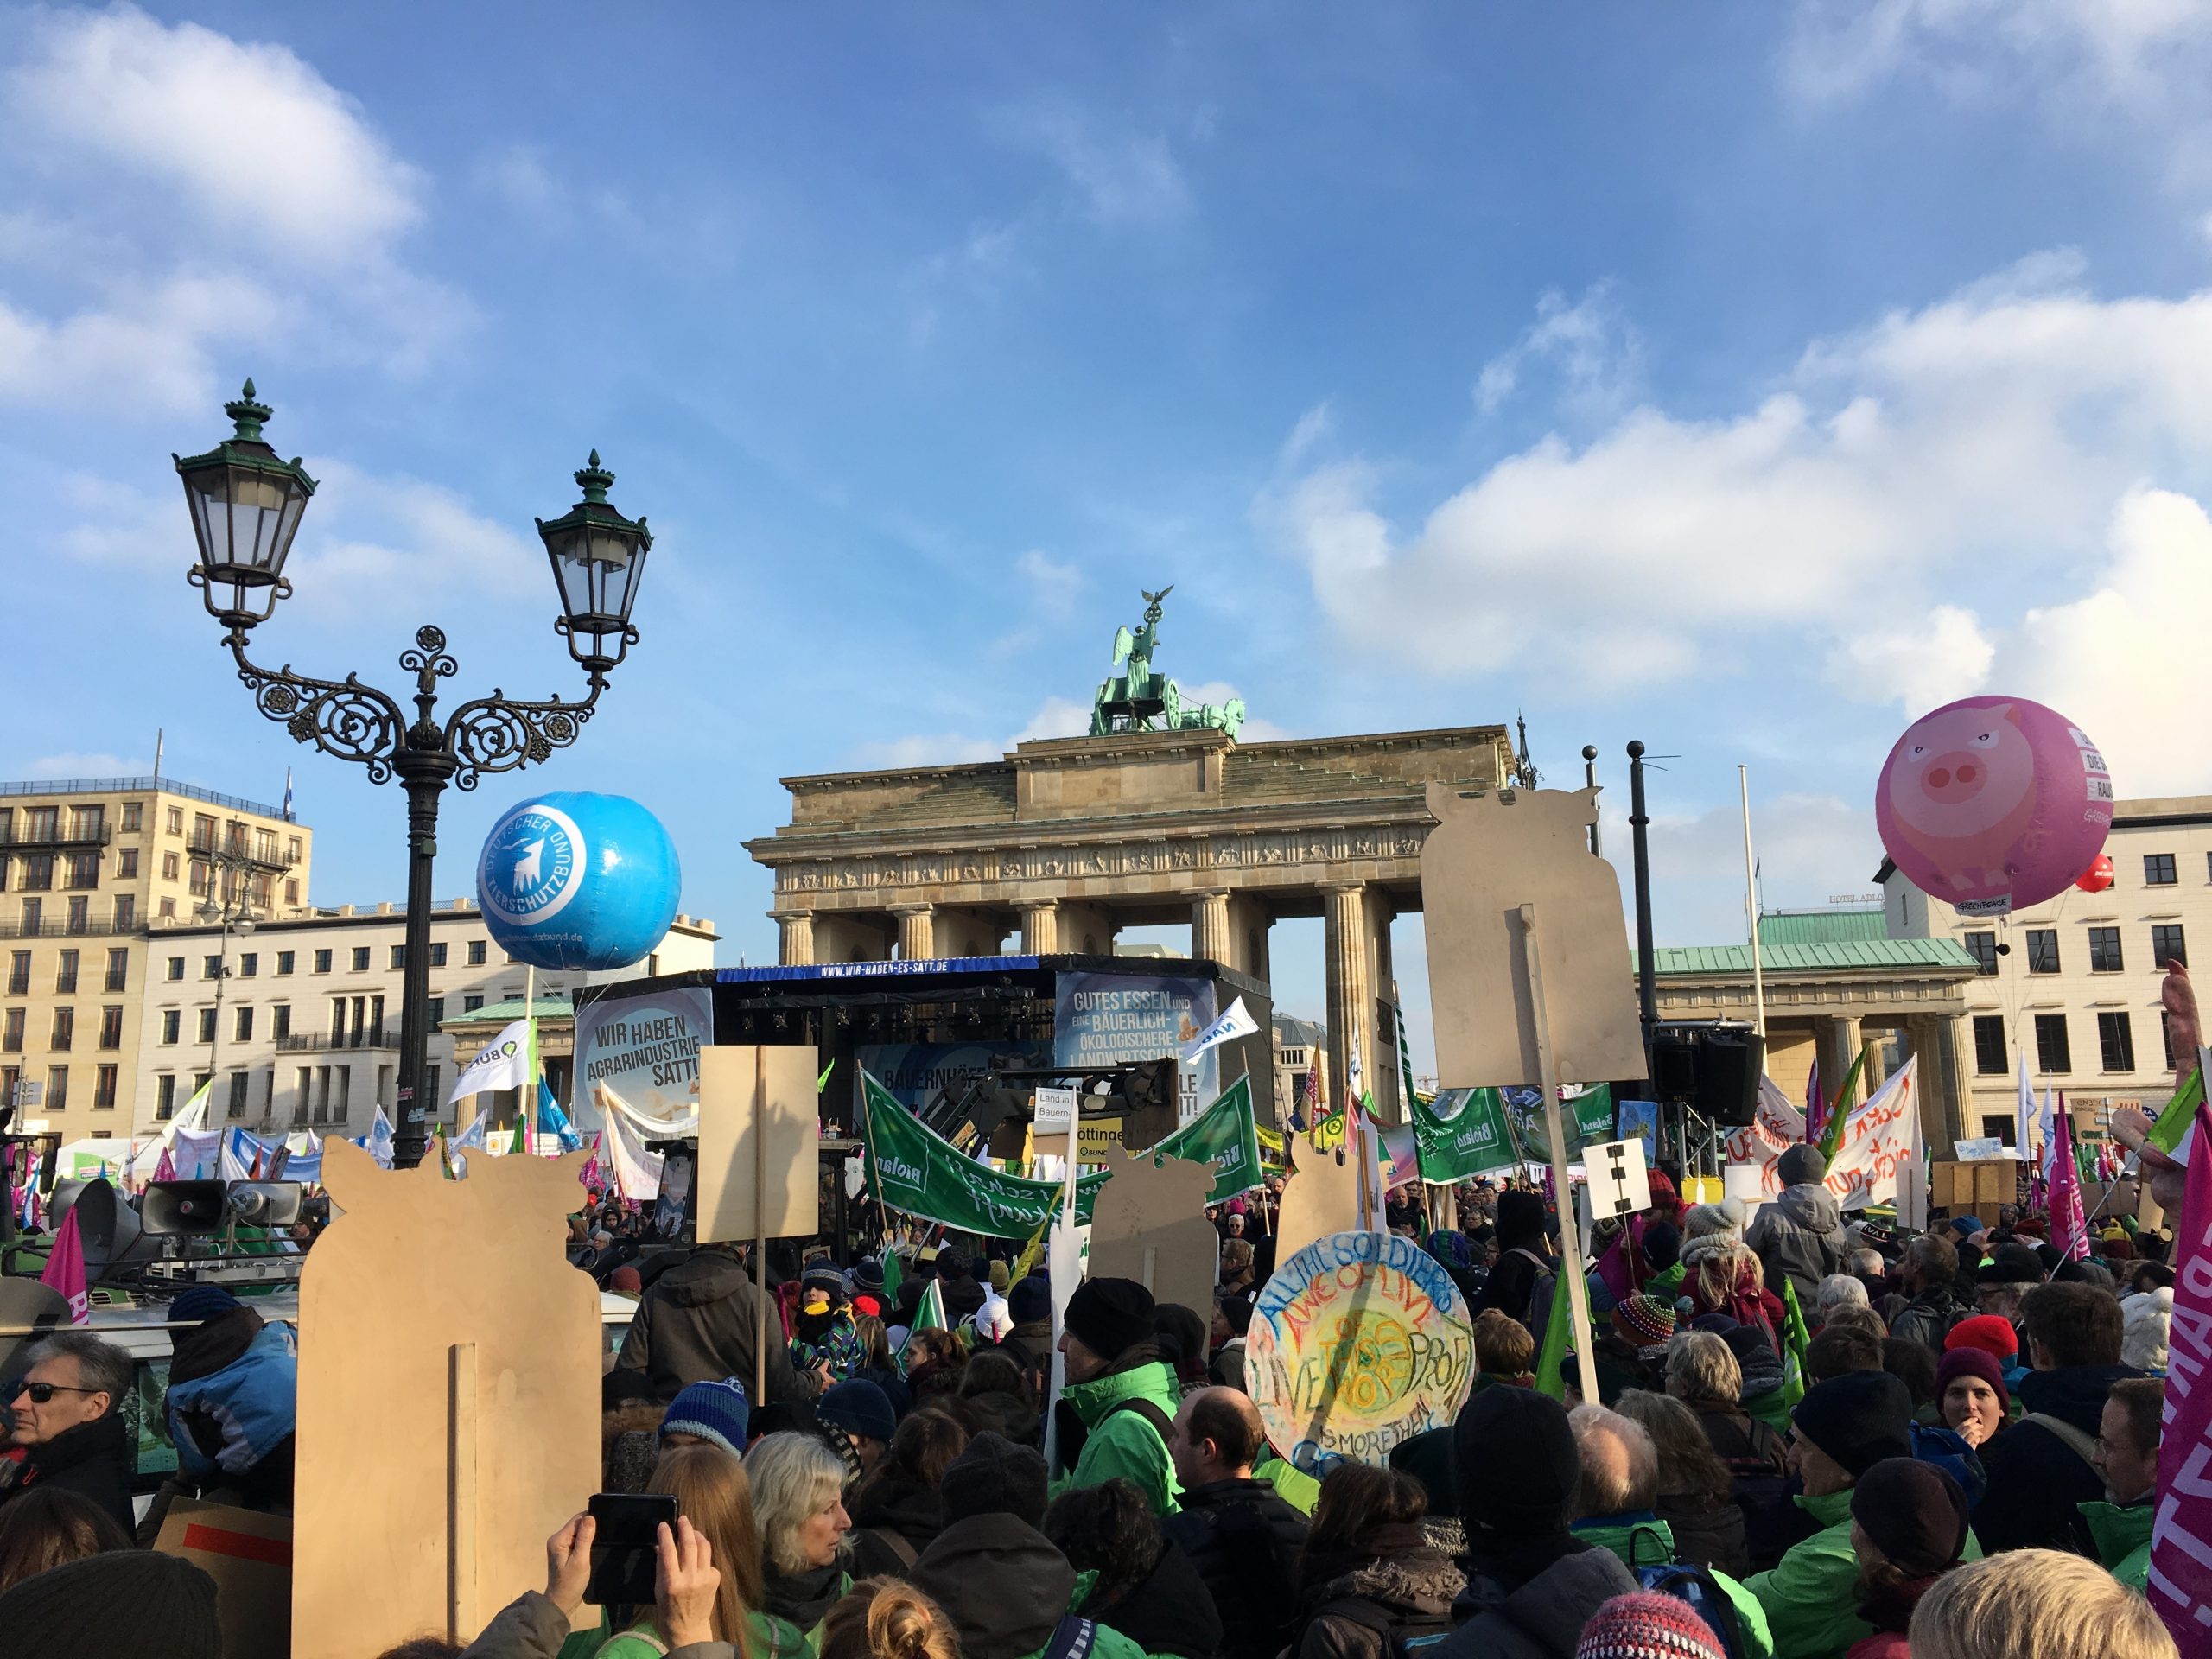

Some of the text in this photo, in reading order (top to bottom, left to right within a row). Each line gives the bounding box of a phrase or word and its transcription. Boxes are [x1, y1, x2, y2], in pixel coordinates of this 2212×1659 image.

[1958, 899, 2008, 911] GREENPEACE
[821, 961, 948, 977] WWW.WIR-HABEN-ES-SATT.DE
[1073, 990, 1191, 1012] GUTES ESSEN UND
[594, 1015, 686, 1048] WIR HABEN
[1072, 1010, 1171, 1032] EINE BÄUERLICH-
[1080, 1030, 1173, 1051] ÖKOLOGISCHERE
[588, 1036, 700, 1081] AGRARINDUSTRIE
[652, 1058, 699, 1086] SATT!
[1039, 1094, 1070, 1103] Land in
[1039, 1108, 1071, 1117] Bauern-
[1336, 1261, 1375, 1290] OF
[1319, 1426, 1337, 1448] IS
[1339, 1430, 1393, 1456] MORE
[1382, 1394, 1431, 1443] THEN
